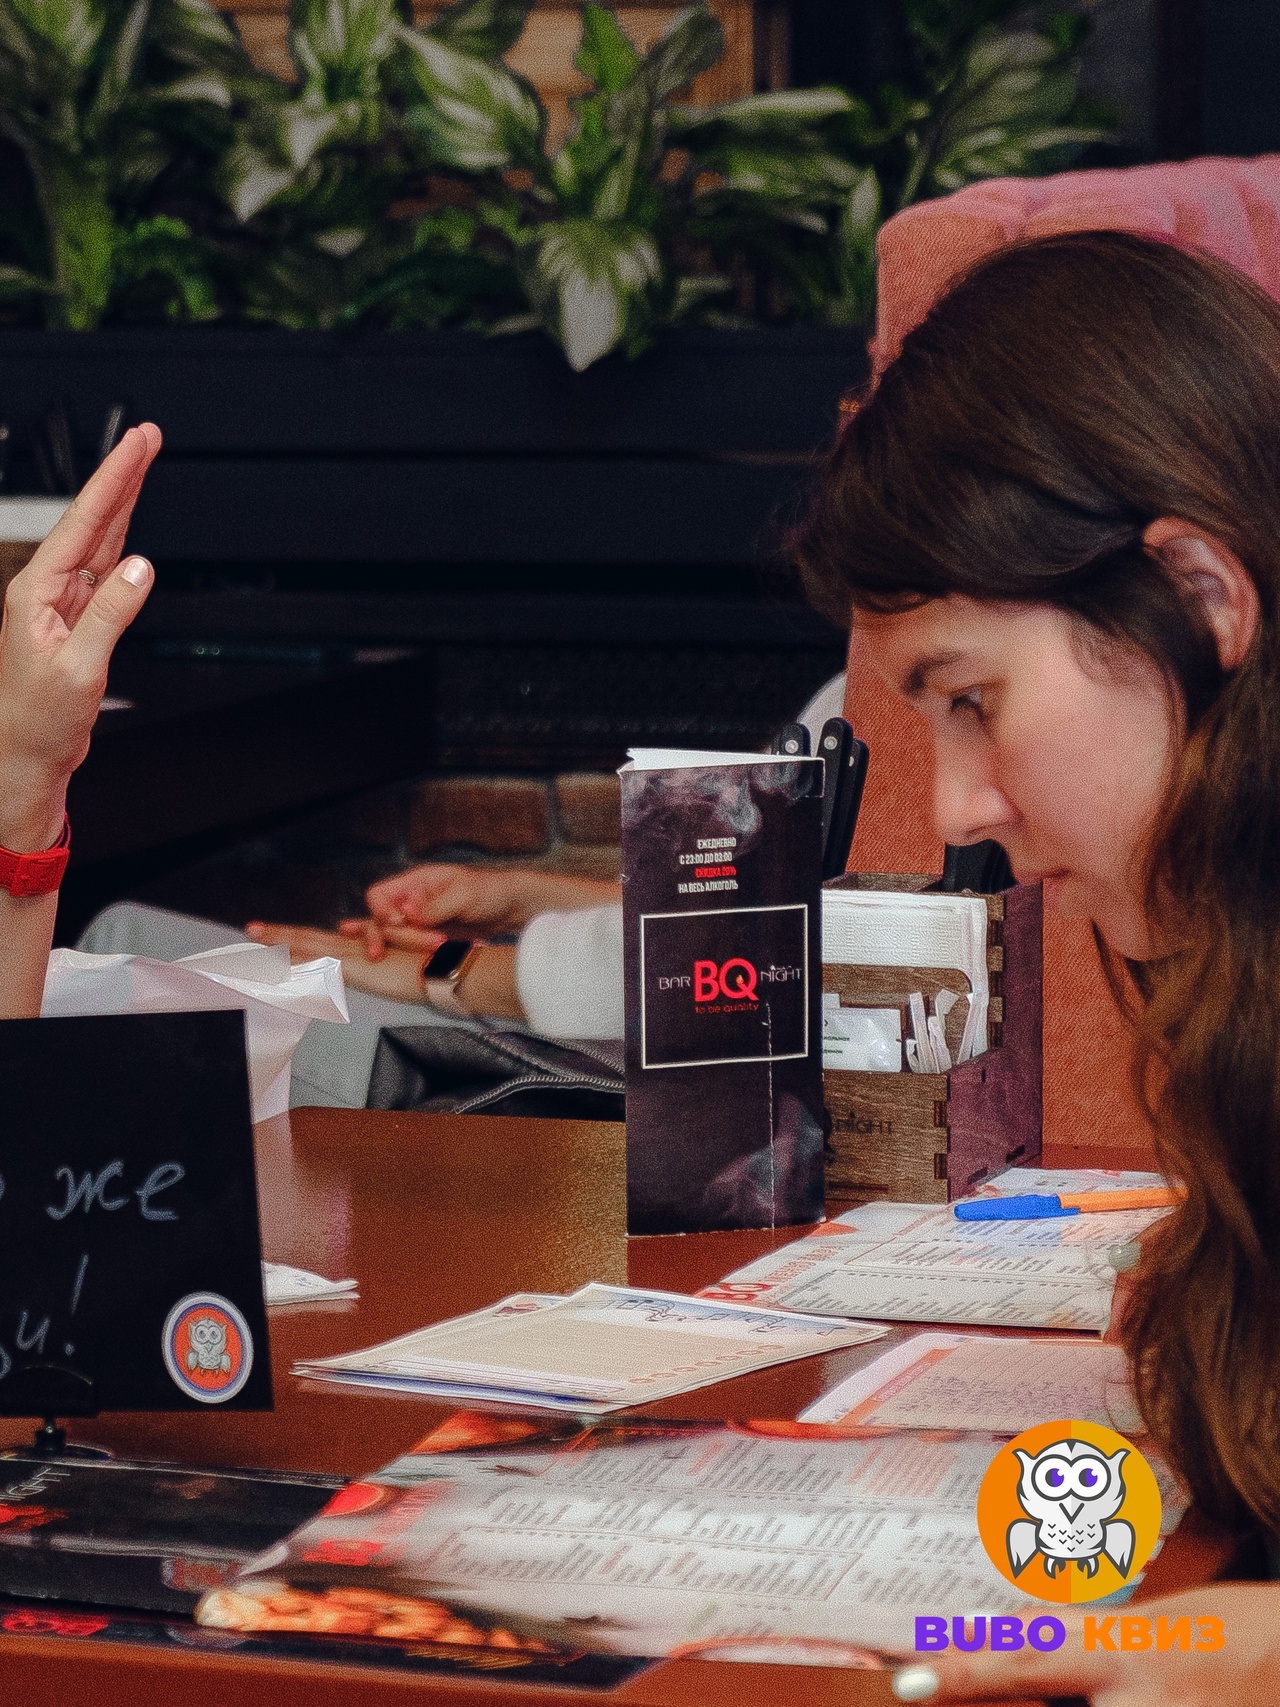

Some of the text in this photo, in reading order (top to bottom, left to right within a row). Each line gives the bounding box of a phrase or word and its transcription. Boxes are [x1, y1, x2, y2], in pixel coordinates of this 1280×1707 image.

[697, 837, 737, 849] ЕЖЕДНЕВНО
[679, 854, 685, 865] С
[685, 853, 704, 864] 23:00
[704, 853, 714, 864] ДО
[695, 867, 722, 878] СКИДКА
[678, 879, 739, 893] НА ВЕСЬ АЛКОГОЛЬ
[659, 957, 803, 1003] BAR BQ NIGHT
[695, 1002, 760, 1014] to be quality
[46, 1161, 185, 1220] же
